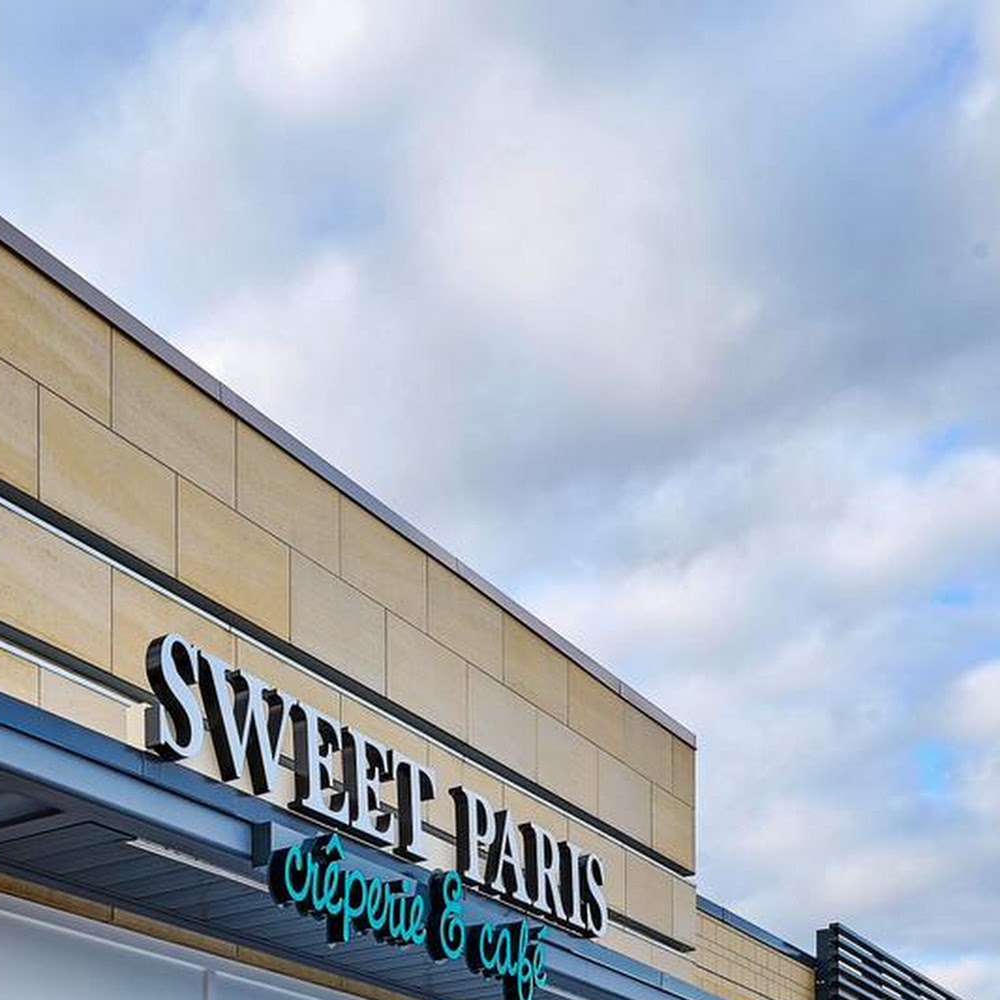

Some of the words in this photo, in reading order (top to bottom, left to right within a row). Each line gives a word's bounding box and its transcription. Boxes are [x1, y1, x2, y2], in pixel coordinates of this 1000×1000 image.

[147, 634, 437, 860] SWEET
[450, 786, 609, 938] PARIS
[285, 833, 427, 944] crêperie
